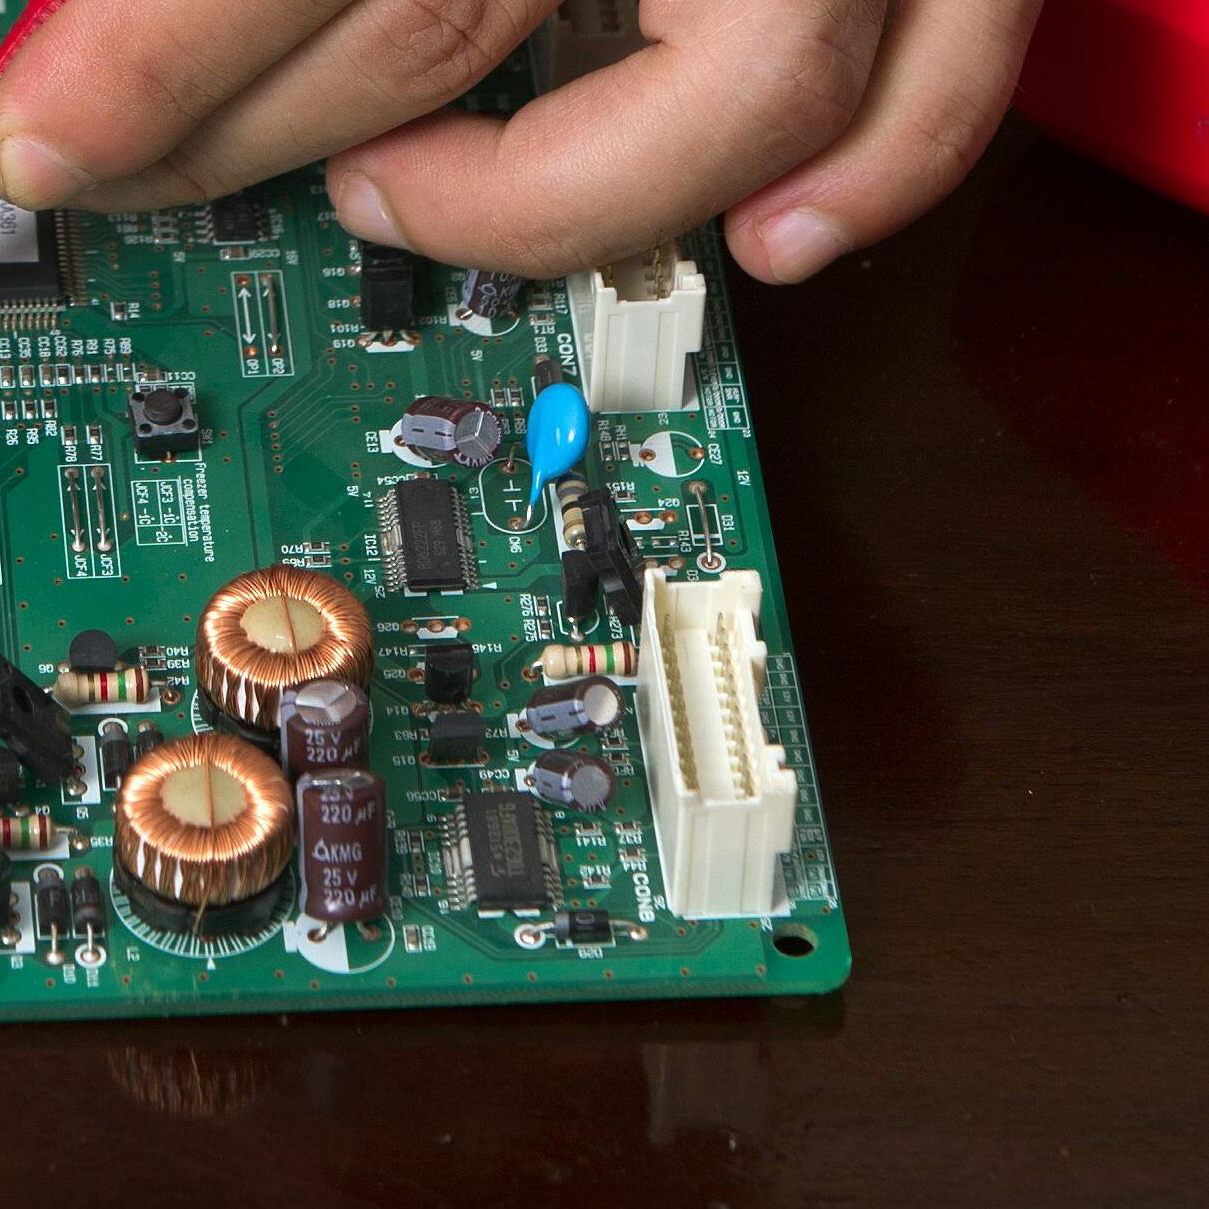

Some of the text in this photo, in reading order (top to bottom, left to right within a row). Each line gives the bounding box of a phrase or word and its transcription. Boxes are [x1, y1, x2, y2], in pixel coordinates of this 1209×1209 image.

[128, 302, 141, 318] R14
[330, 324, 359, 333] R101
[72, 340, 83, 356] R76
[534, 336, 546, 352] D33
[557, 333, 577, 376] CON7
[657, 412, 669, 425] 23
[6, 429, 18, 445] R26
[201, 429, 213, 444] SW1
[598, 419, 611, 442] R148
[365, 431, 379, 453] CE13
[65, 446, 77, 462] R78
[90, 445, 102, 460] R77
[736, 470, 751, 486] 12V
[136, 482, 148, 504] JCF4
[160, 482, 173, 503] JCF3
[347, 485, 358, 497] 5V
[183, 479, 199, 542] compensation
[657, 498, 680, 507] Q24
[195, 463, 215, 562] Freezer temperature
[721, 514, 735, 531] D31
[281, 544, 304, 554] R70
[365, 534, 377, 555] IC12
[677, 530, 692, 553] R143
[75, 555, 87, 577] JCF4
[100, 554, 113, 575] JCF3
[364, 569, 376, 584] 12V
[519, 594, 531, 616] R276
[522, 619, 536, 642] R275
[166, 647, 189, 656] R40
[378, 647, 408, 656] R147
[167, 659, 189, 669] R39
[166, 676, 189, 685] R42
[386, 706, 408, 715] Q14
[305, 729, 342, 745] 25 V
[307, 747, 338, 762] 220
[479, 769, 510, 779] CC49
[35, 806, 50, 815] Q4
[321, 804, 352, 824] 220
[576, 837, 607, 847] R141
[330, 842, 362, 862] KMG
[323, 868, 358, 886] 25 V
[324, 889, 354, 907] 220
[632, 872, 650, 922] CON8
